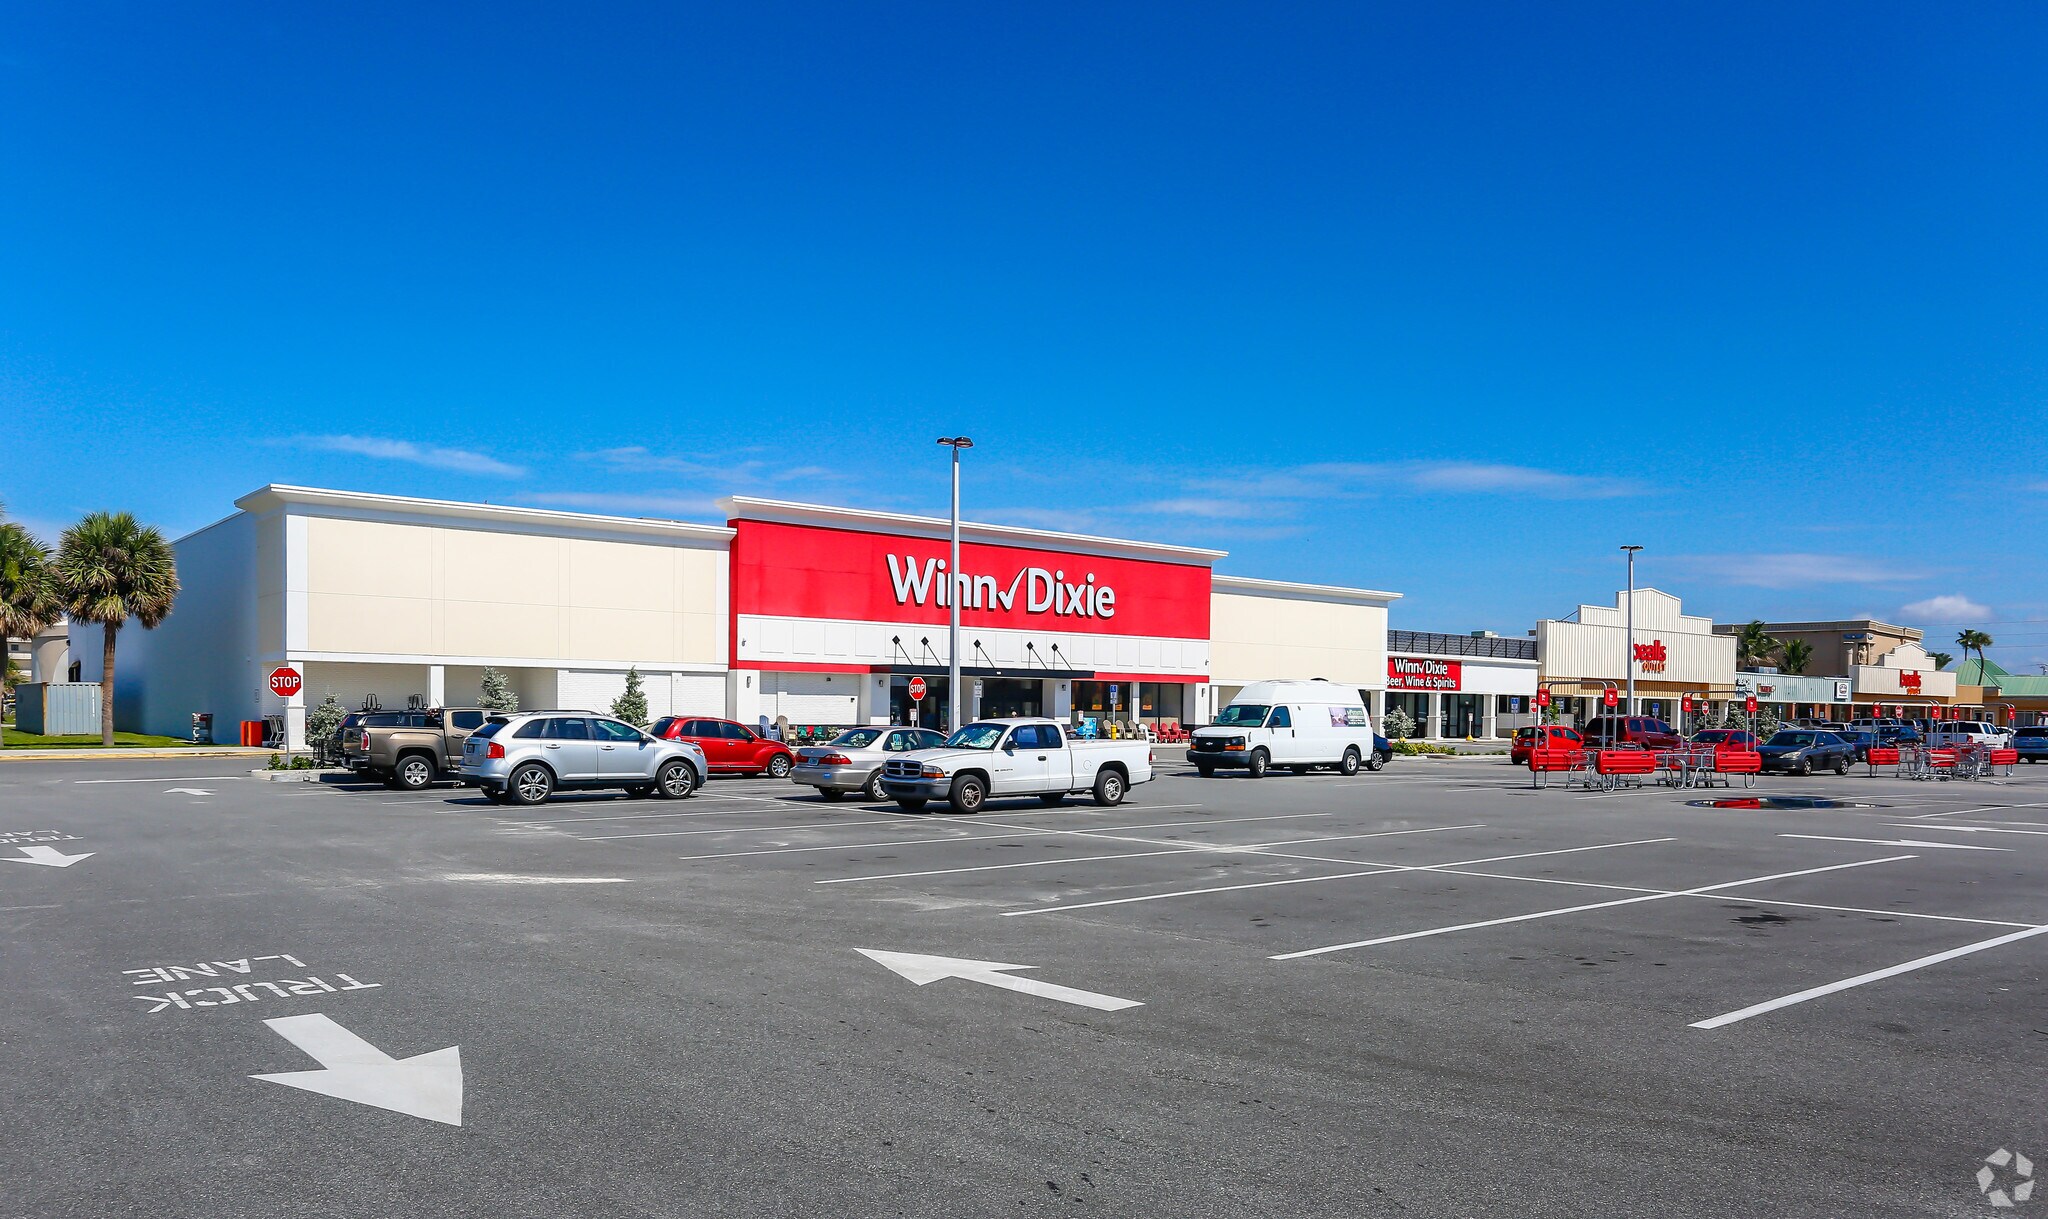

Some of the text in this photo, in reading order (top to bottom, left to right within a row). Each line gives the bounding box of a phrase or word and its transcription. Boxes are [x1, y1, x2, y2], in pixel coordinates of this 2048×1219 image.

[1027, 567, 1116, 618] Dixie
[1394, 658, 1448, 675] Winn Dixie
[271, 676, 300, 688] STOP
[910, 684, 925, 694] STOP
[1405, 675, 1424, 687] Wine
[1425, 676, 1432, 687] &
[1433, 676, 1456, 691] Spirits
[122, 954, 307, 985] LANE
[132, 973, 383, 1013] TRUCK
